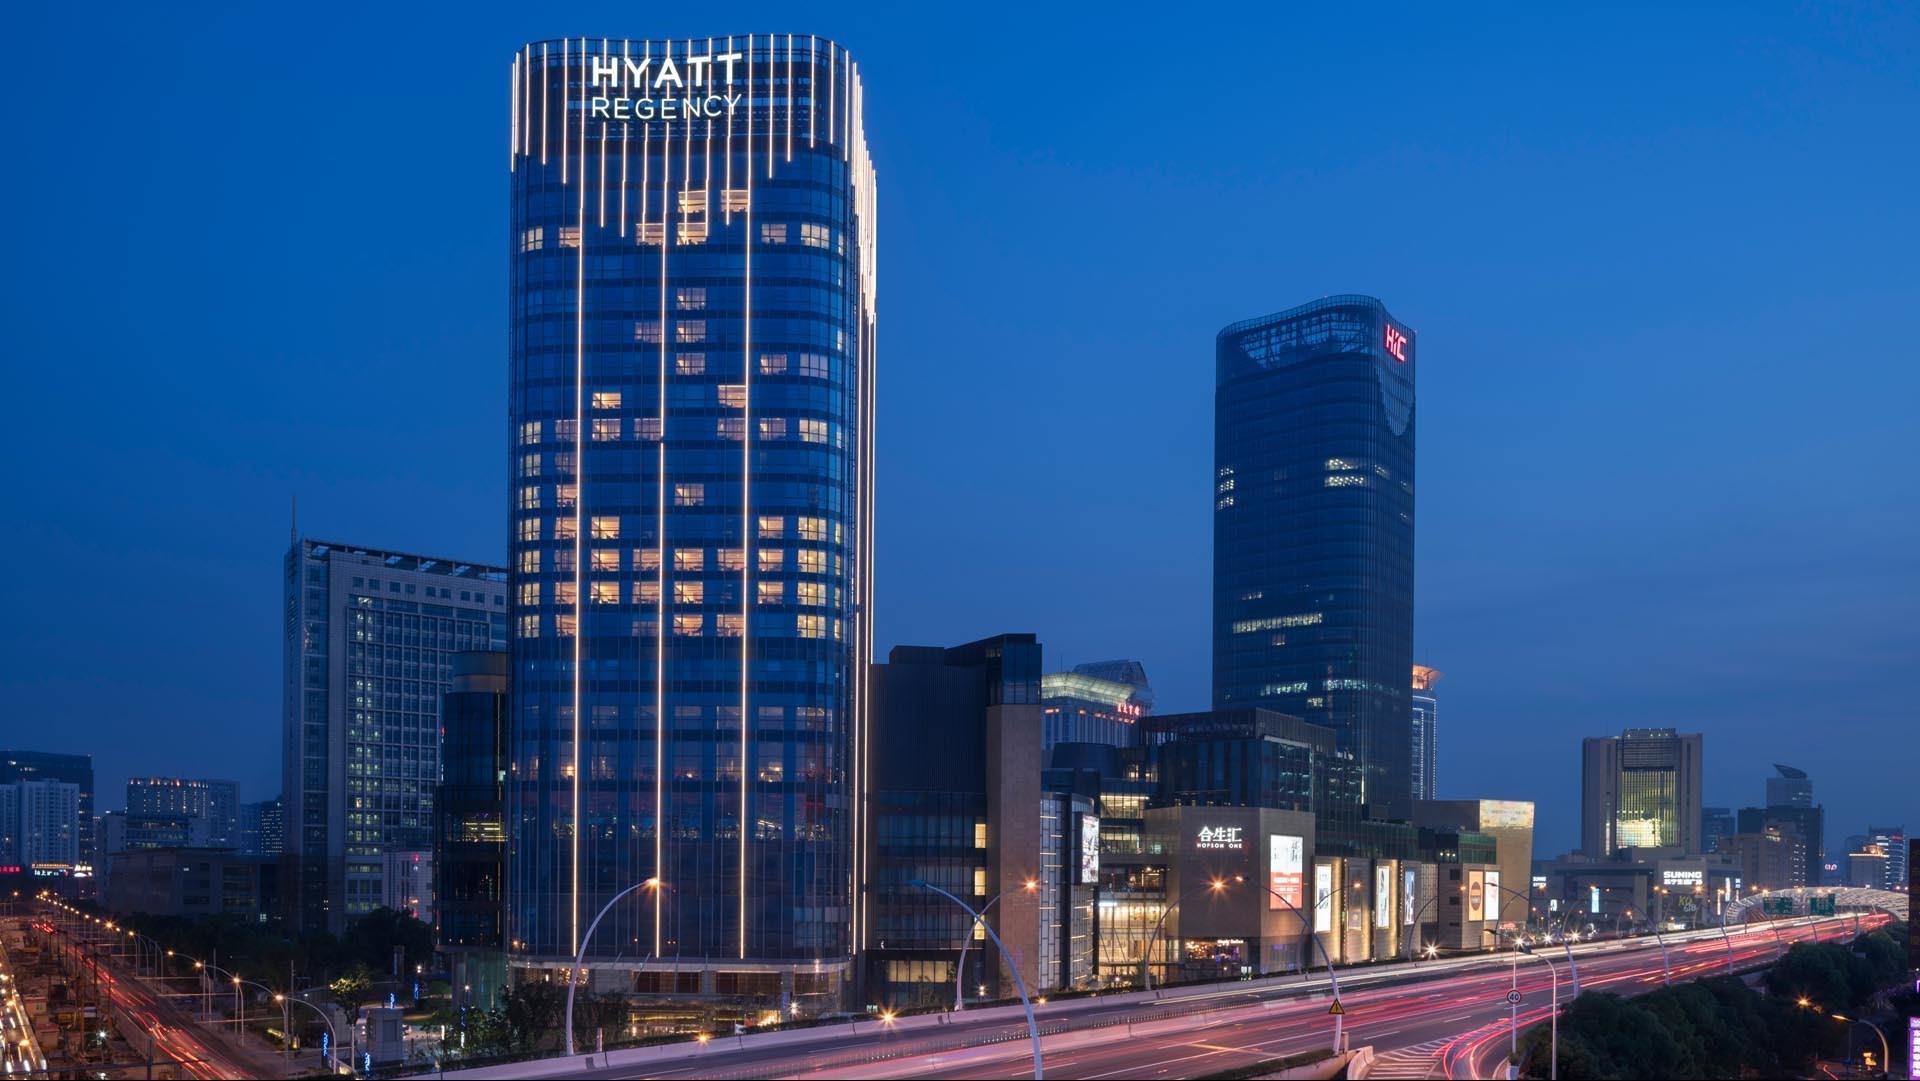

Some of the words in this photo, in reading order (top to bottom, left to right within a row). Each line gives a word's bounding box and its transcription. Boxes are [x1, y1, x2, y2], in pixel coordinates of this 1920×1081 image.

[592, 53, 742, 88] HYATT
[592, 93, 742, 119] REGENCY
[1198, 826, 1242, 842] 合生汇
[1663, 871, 1702, 879] SUNING
[1509, 993, 1520, 1001] 40
